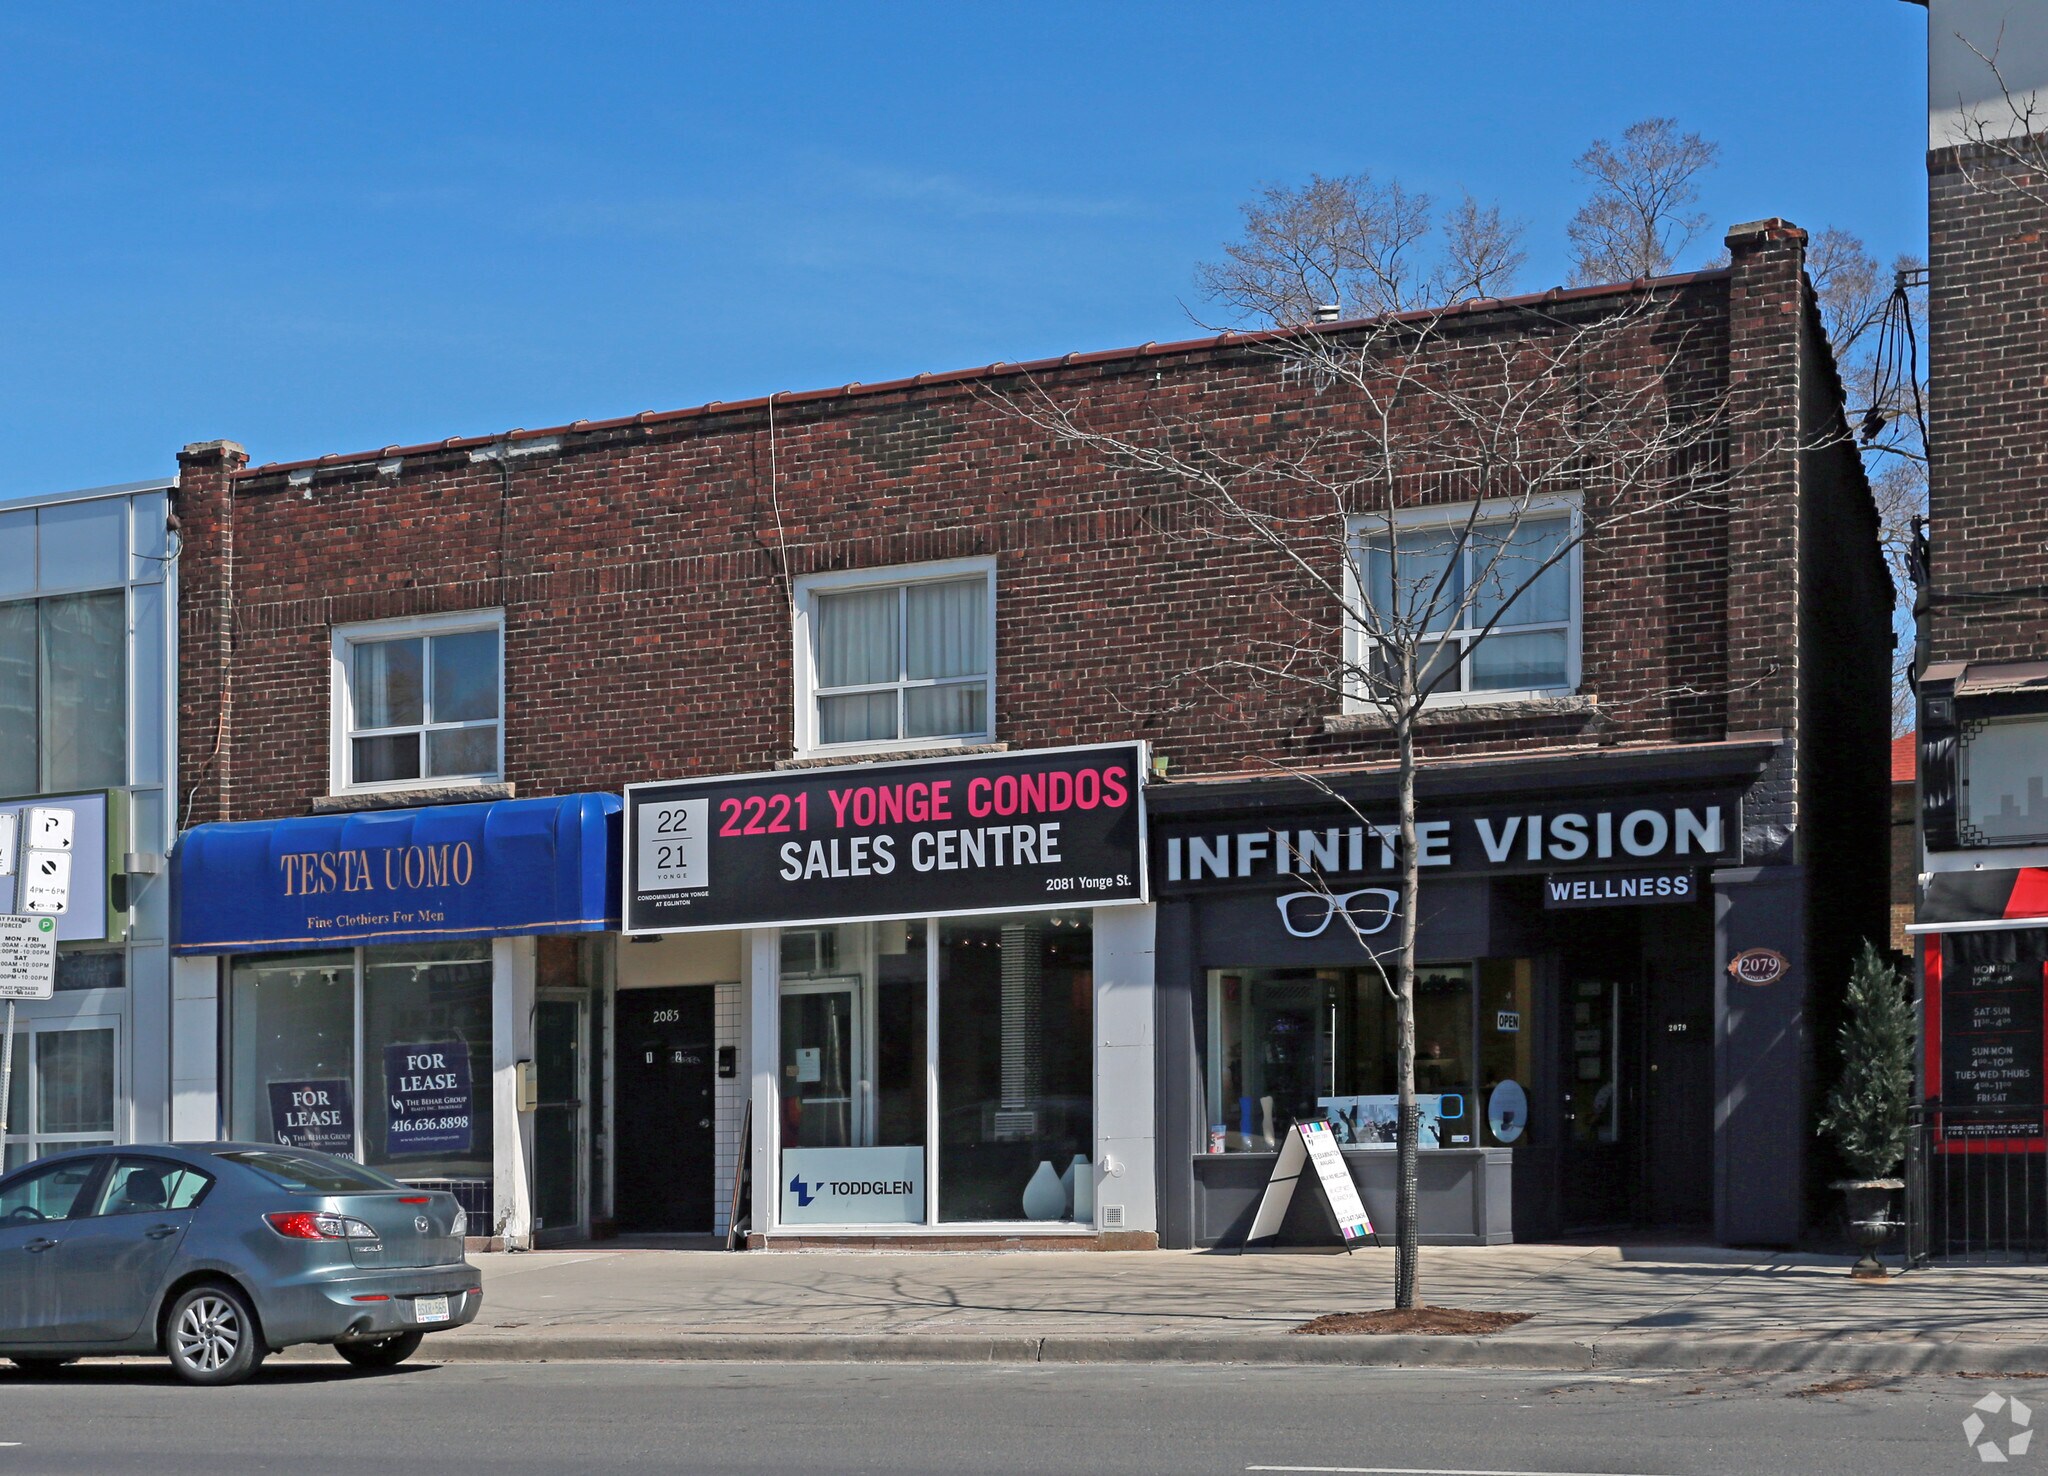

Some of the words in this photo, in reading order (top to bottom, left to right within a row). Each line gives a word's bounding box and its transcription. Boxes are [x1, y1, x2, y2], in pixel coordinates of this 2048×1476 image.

[720, 792, 807, 837] 2221
[828, 780, 951, 828] YONGE
[968, 766, 1128, 818] CONDOS
[658, 809, 687, 834] 22
[780, 834, 896, 881] SALES
[912, 822, 1061, 872] CENTRE
[1168, 821, 1450, 881] INFINITE
[1474, 806, 1721, 862] VISION
[658, 845, 686, 869] 21
[281, 850, 374, 896] TESTA
[383, 842, 472, 890] UOMO
[1046, 877, 1074, 891] 2081
[1079, 876, 1112, 890] Yonge
[1117, 874, 1131, 886] St.
[1551, 876, 1689, 900] WELLNESS
[638, 892, 679, 901] CONDOMINIUMS
[307, 916, 332, 929] Fine
[336, 912, 389, 927] Clothiers
[392, 911, 414, 923] For
[418, 910, 445, 922] Men
[1742, 958, 1777, 971] 2079
[653, 1010, 679, 1023] 2085
[1498, 1015, 1519, 1028] OPEN
[1668, 1023, 1687, 1032] 2079
[406, 1054, 446, 1071] FOR
[400, 1074, 458, 1092] LEASE
[292, 1091, 330, 1107] FOR
[444, 1096, 467, 1104] GROUP
[286, 1110, 342, 1127] LEASE
[392, 1116, 468, 1132] 416.636.8898
[830, 1181, 913, 1196] TODDGLEN
